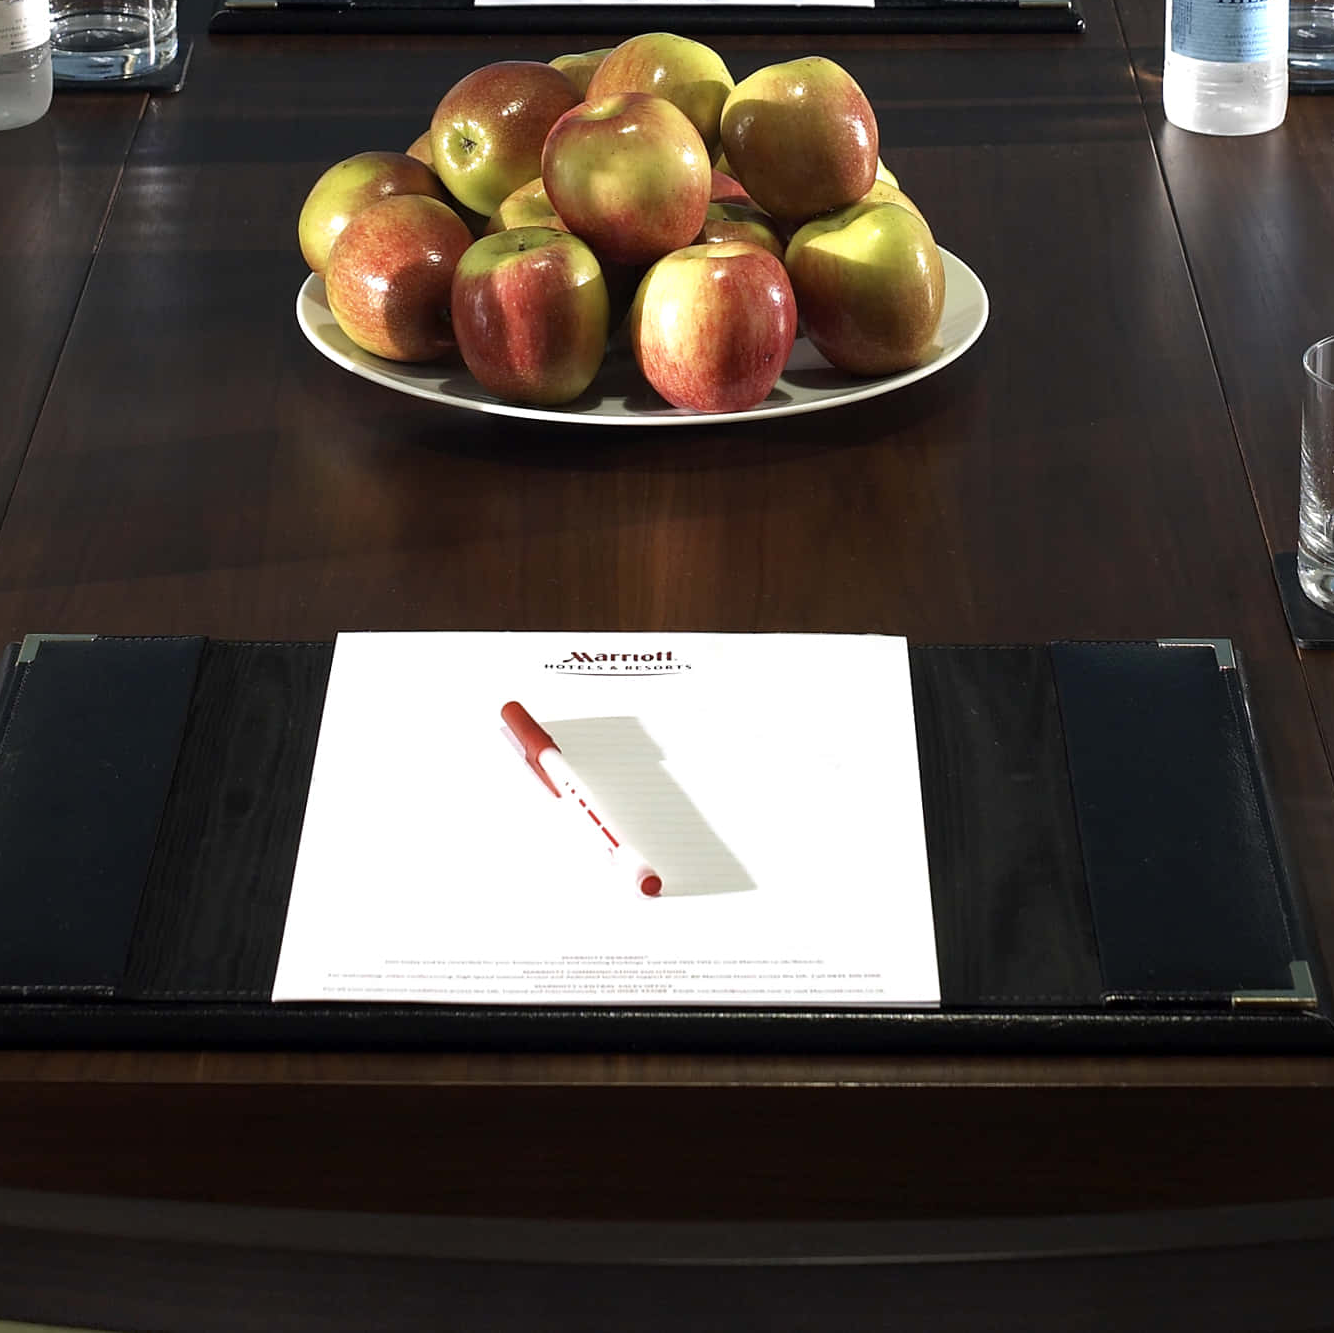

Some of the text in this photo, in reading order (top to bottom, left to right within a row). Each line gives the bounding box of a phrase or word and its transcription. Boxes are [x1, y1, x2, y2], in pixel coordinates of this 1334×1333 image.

[562, 651, 673, 663] Marriott
[544, 663, 603, 671] HOTELS
[625, 663, 692, 671] RESORTS
